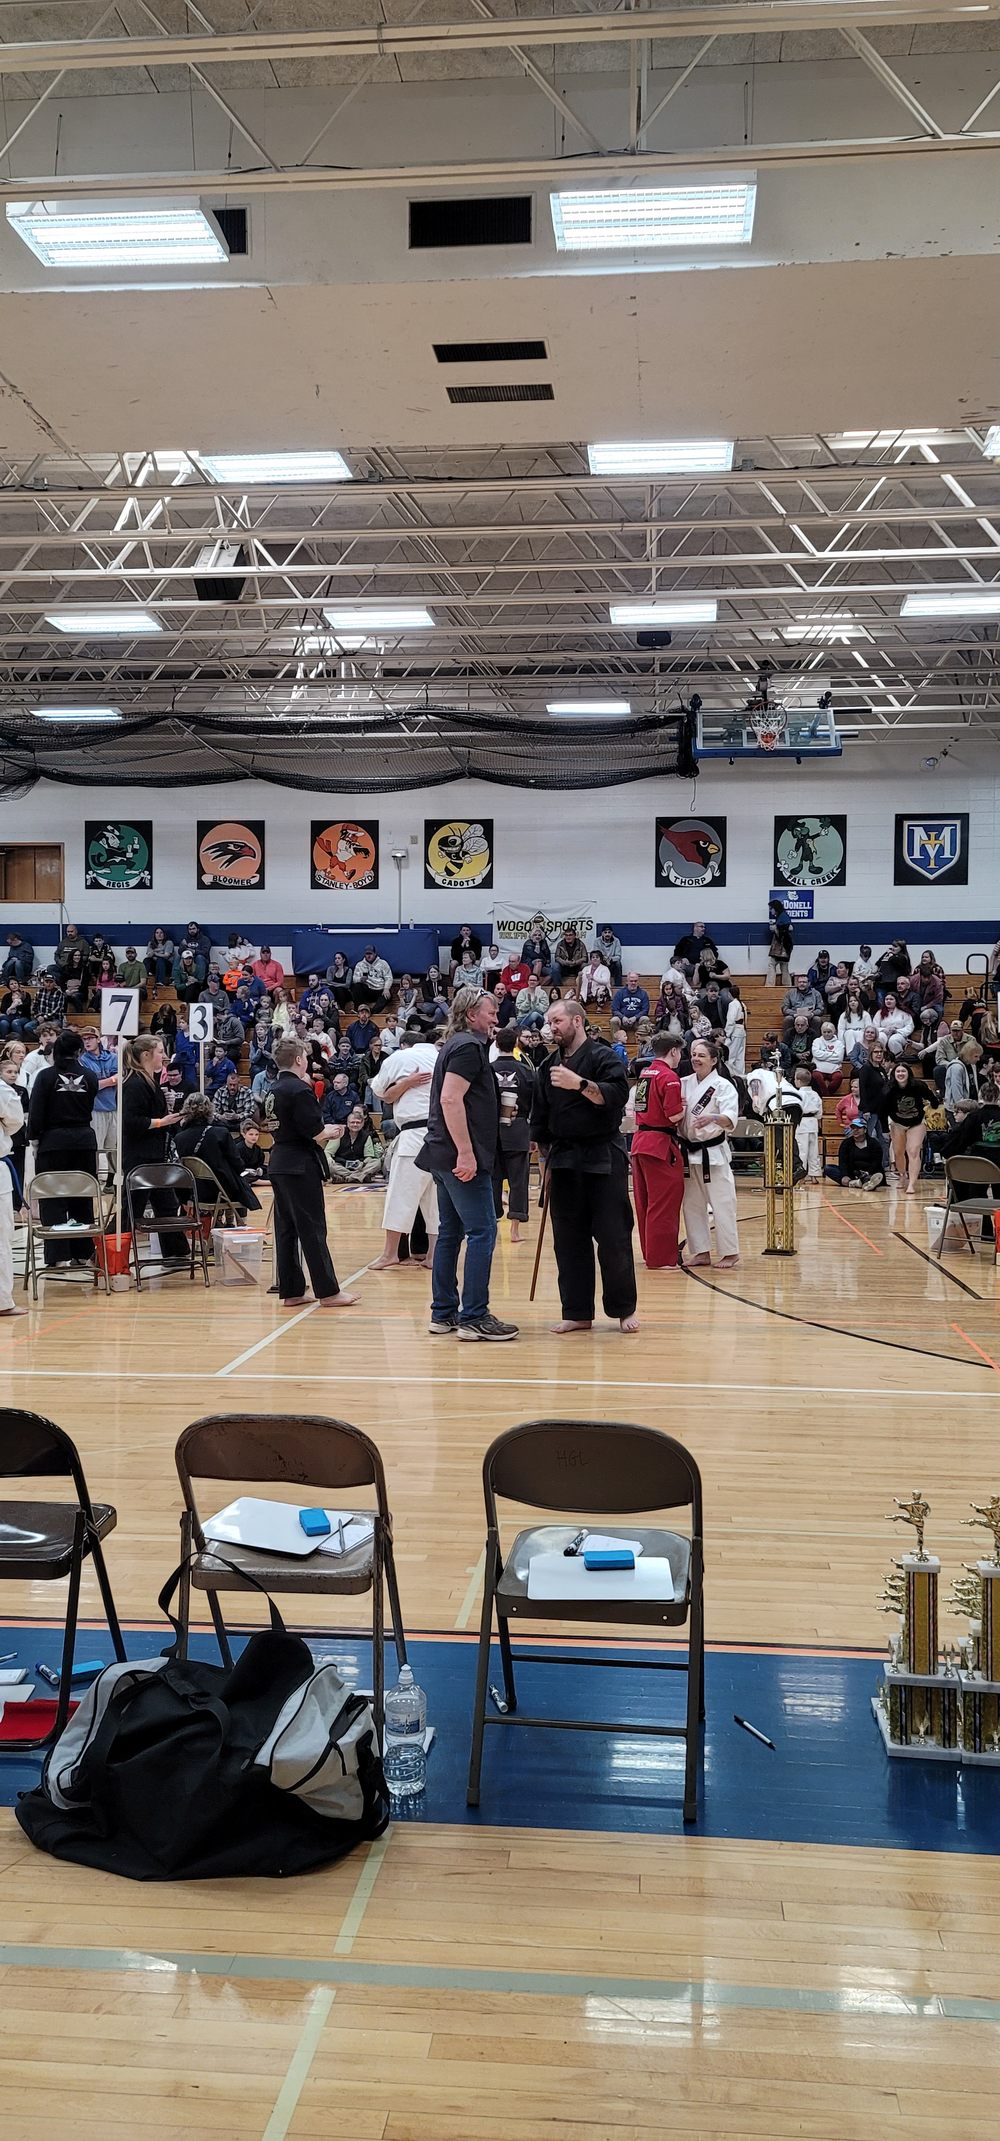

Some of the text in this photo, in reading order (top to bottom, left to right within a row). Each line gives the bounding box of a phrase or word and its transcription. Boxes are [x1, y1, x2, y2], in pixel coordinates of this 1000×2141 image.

[212, 875, 252, 886] BLOOMER
[316, 874, 373, 889] STANLEY-BOYD
[441, 878, 476, 887] CADOTT
[673, 875, 706, 886] THORP
[787, 867, 838, 886] FALL CREEK
[783, 900, 812, 910] DONELL
[496, 920, 594, 932] WOGO SPORTS
[108, 995, 134, 1032] 7
[193, 1005, 209, 1041] 3
